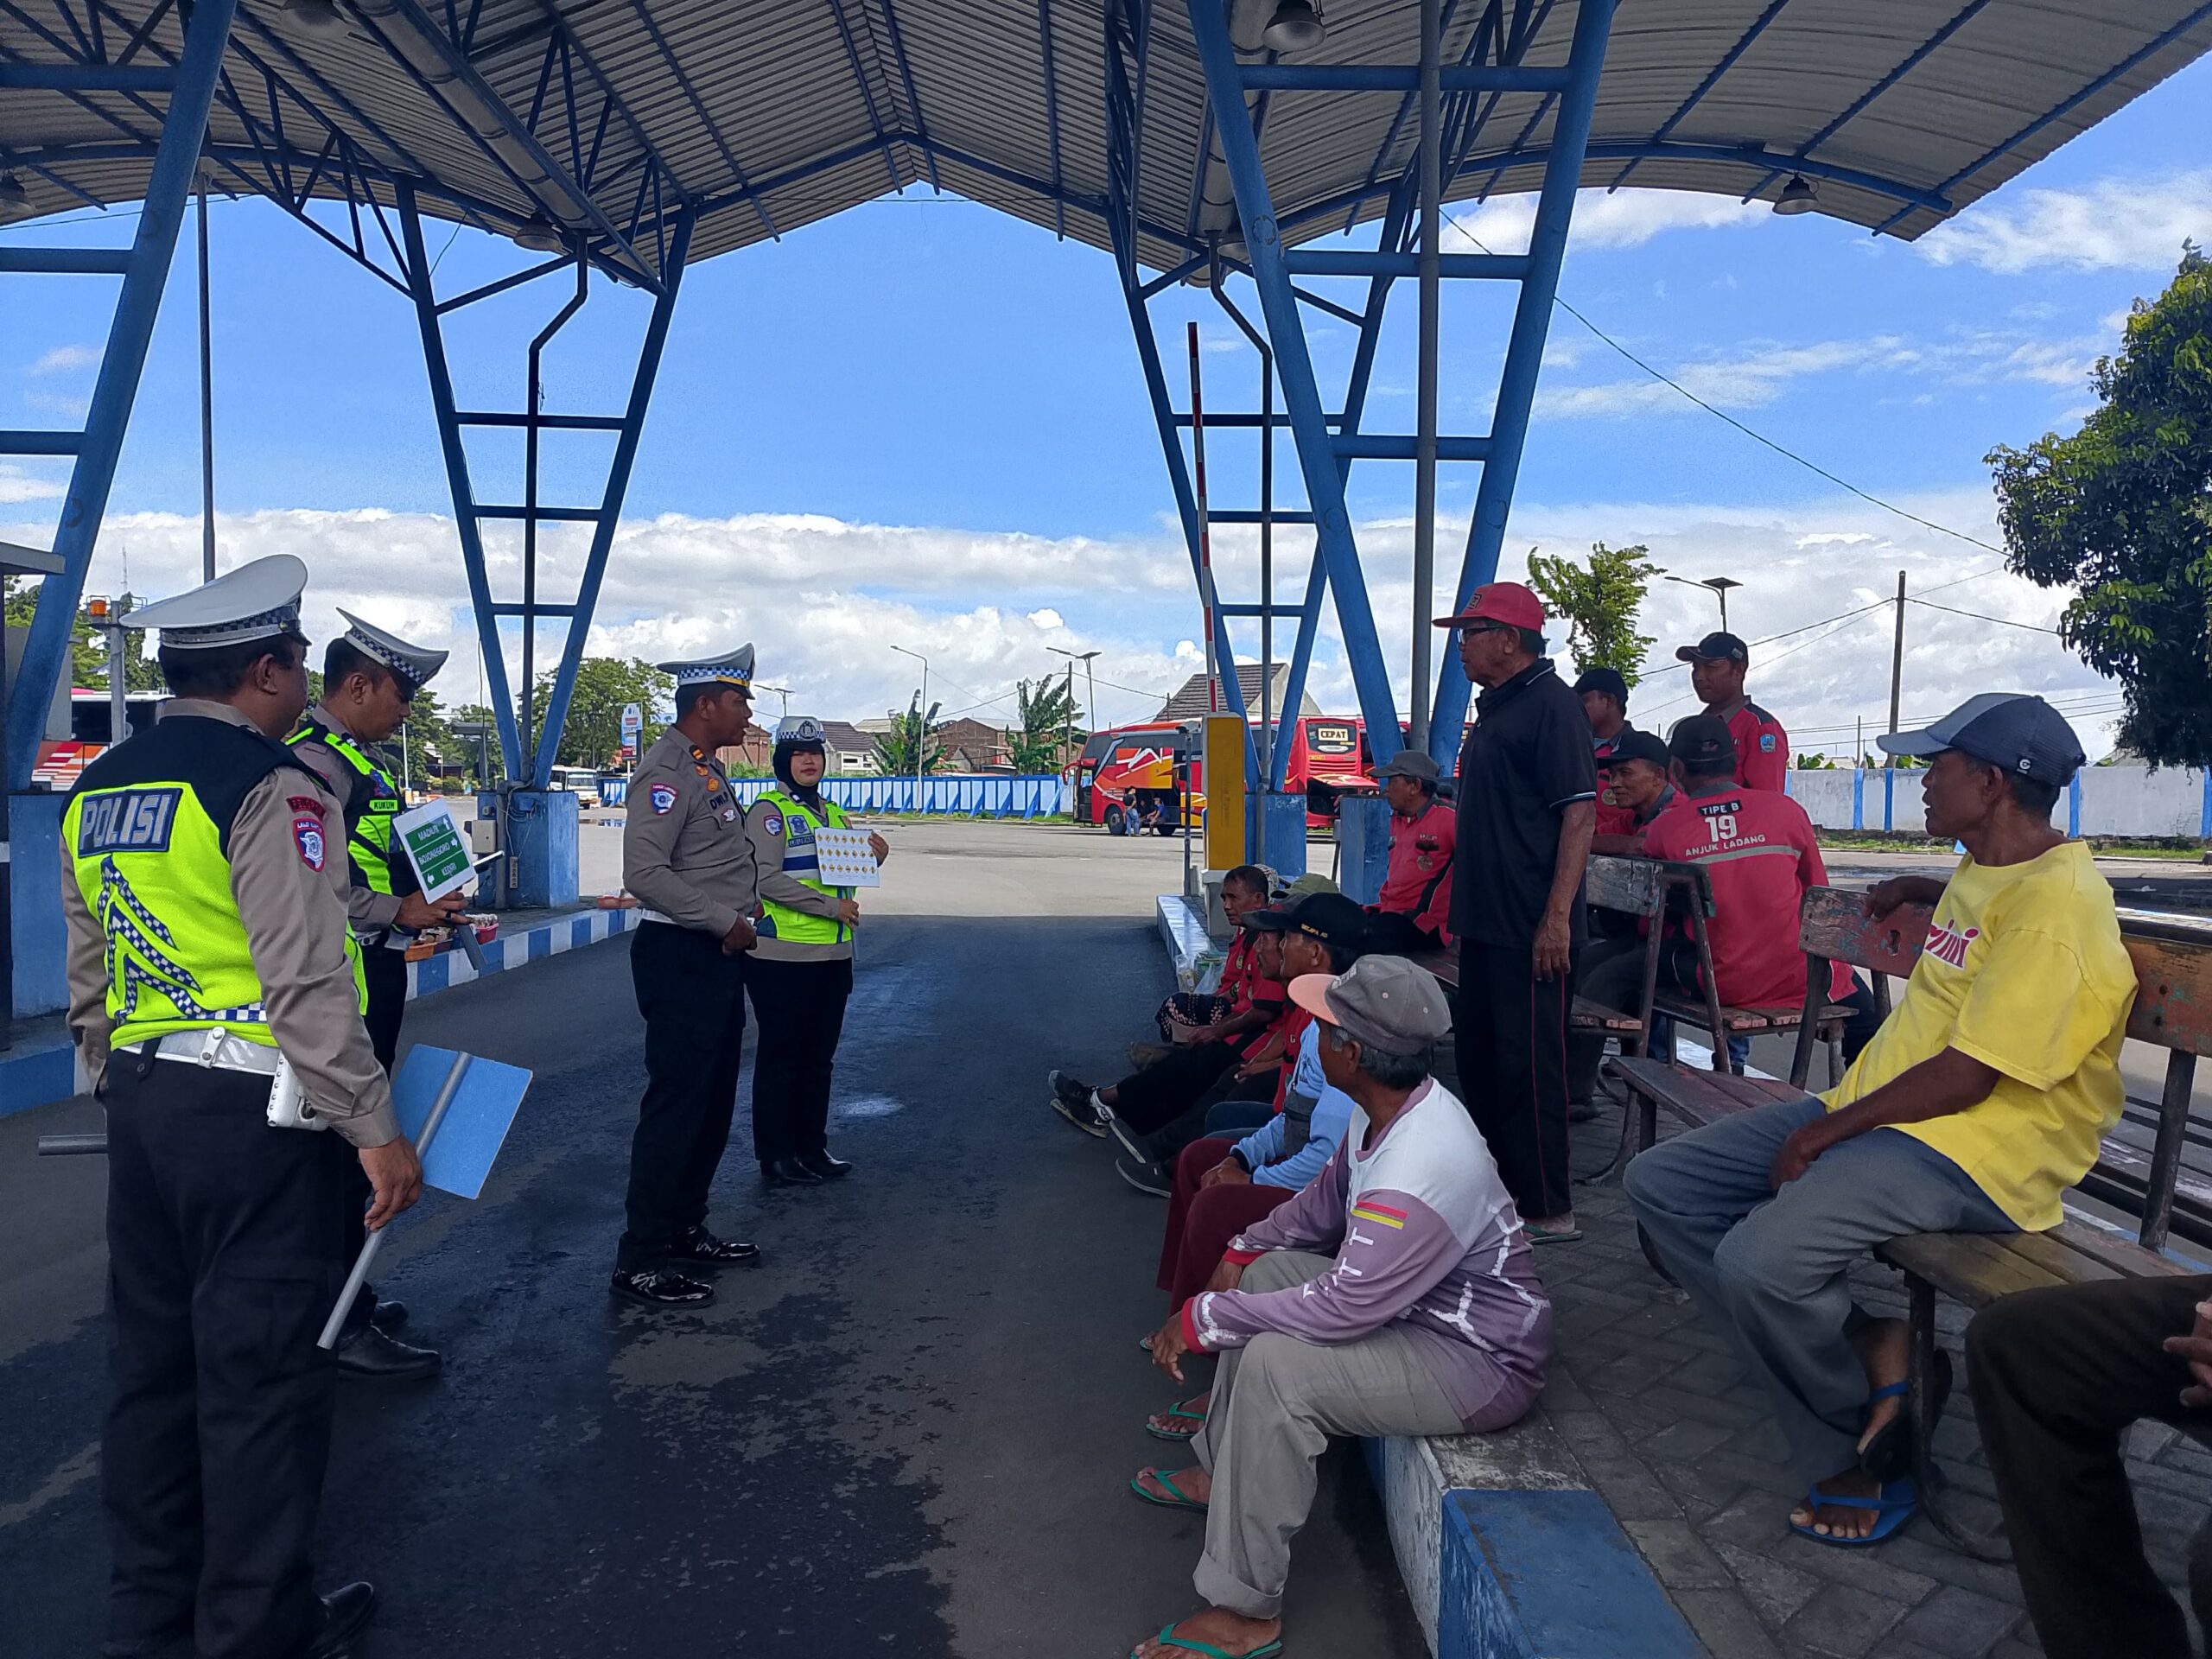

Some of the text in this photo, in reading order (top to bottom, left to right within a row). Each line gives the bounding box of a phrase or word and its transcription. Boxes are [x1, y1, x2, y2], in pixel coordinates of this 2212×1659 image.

[1320, 730, 1346, 739] CEPAT
[1701, 802, 1739, 815] TIPE B
[79, 794, 173, 850] POLISI
[1705, 815, 1738, 842] 19
[1685, 834, 1766, 857] ANJUK LADANG
